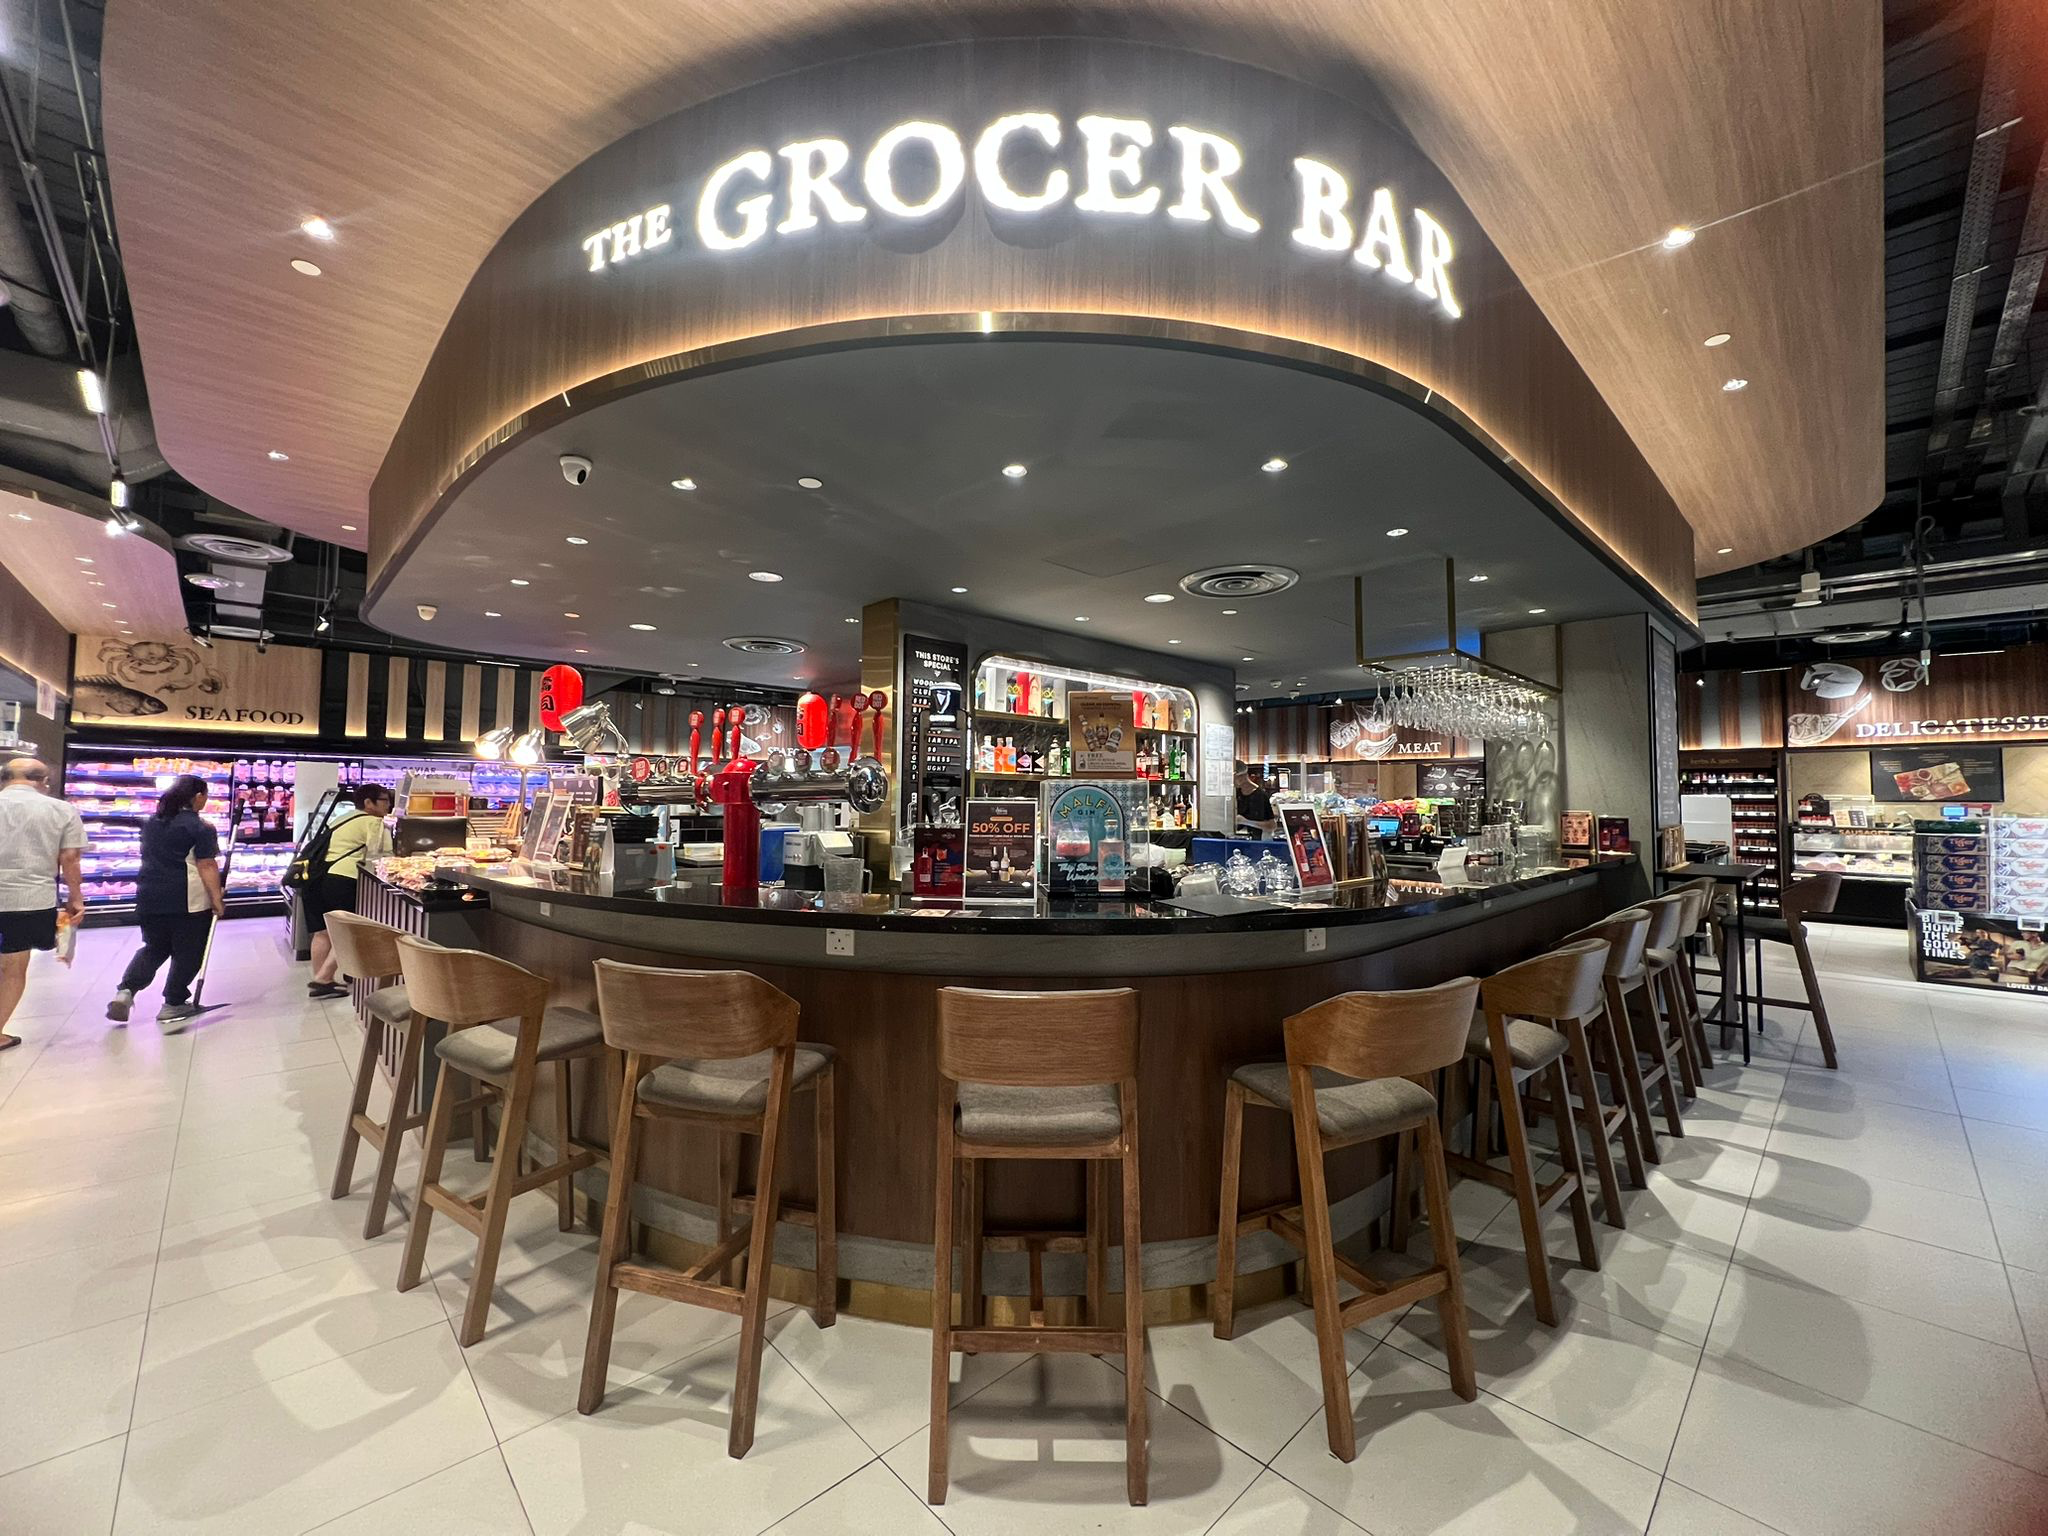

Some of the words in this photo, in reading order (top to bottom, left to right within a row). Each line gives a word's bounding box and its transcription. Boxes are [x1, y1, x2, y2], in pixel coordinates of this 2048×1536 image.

[582, 204, 673, 273] THE
[697, 112, 1261, 251] GROCER
[1292, 156, 1462, 319] BAR
[915, 650, 931, 660] THIS
[932, 653, 960, 664] STORE'S
[923, 660, 951, 671] SPECIAL
[185, 705, 304, 726] SEAFOOD
[1397, 741, 1442, 754] MEAT
[1058, 794, 1115, 819] MALFY
[972, 822, 1000, 833] 50%
[1003, 823, 1031, 833] OFF
[1923, 922, 1963, 934] HOME
[1923, 930, 1949, 941] THE
[1923, 940, 1961, 950] GOOD
[1923, 947, 1966, 960] TIMES
[2006, 982, 2036, 991] LOVELY
